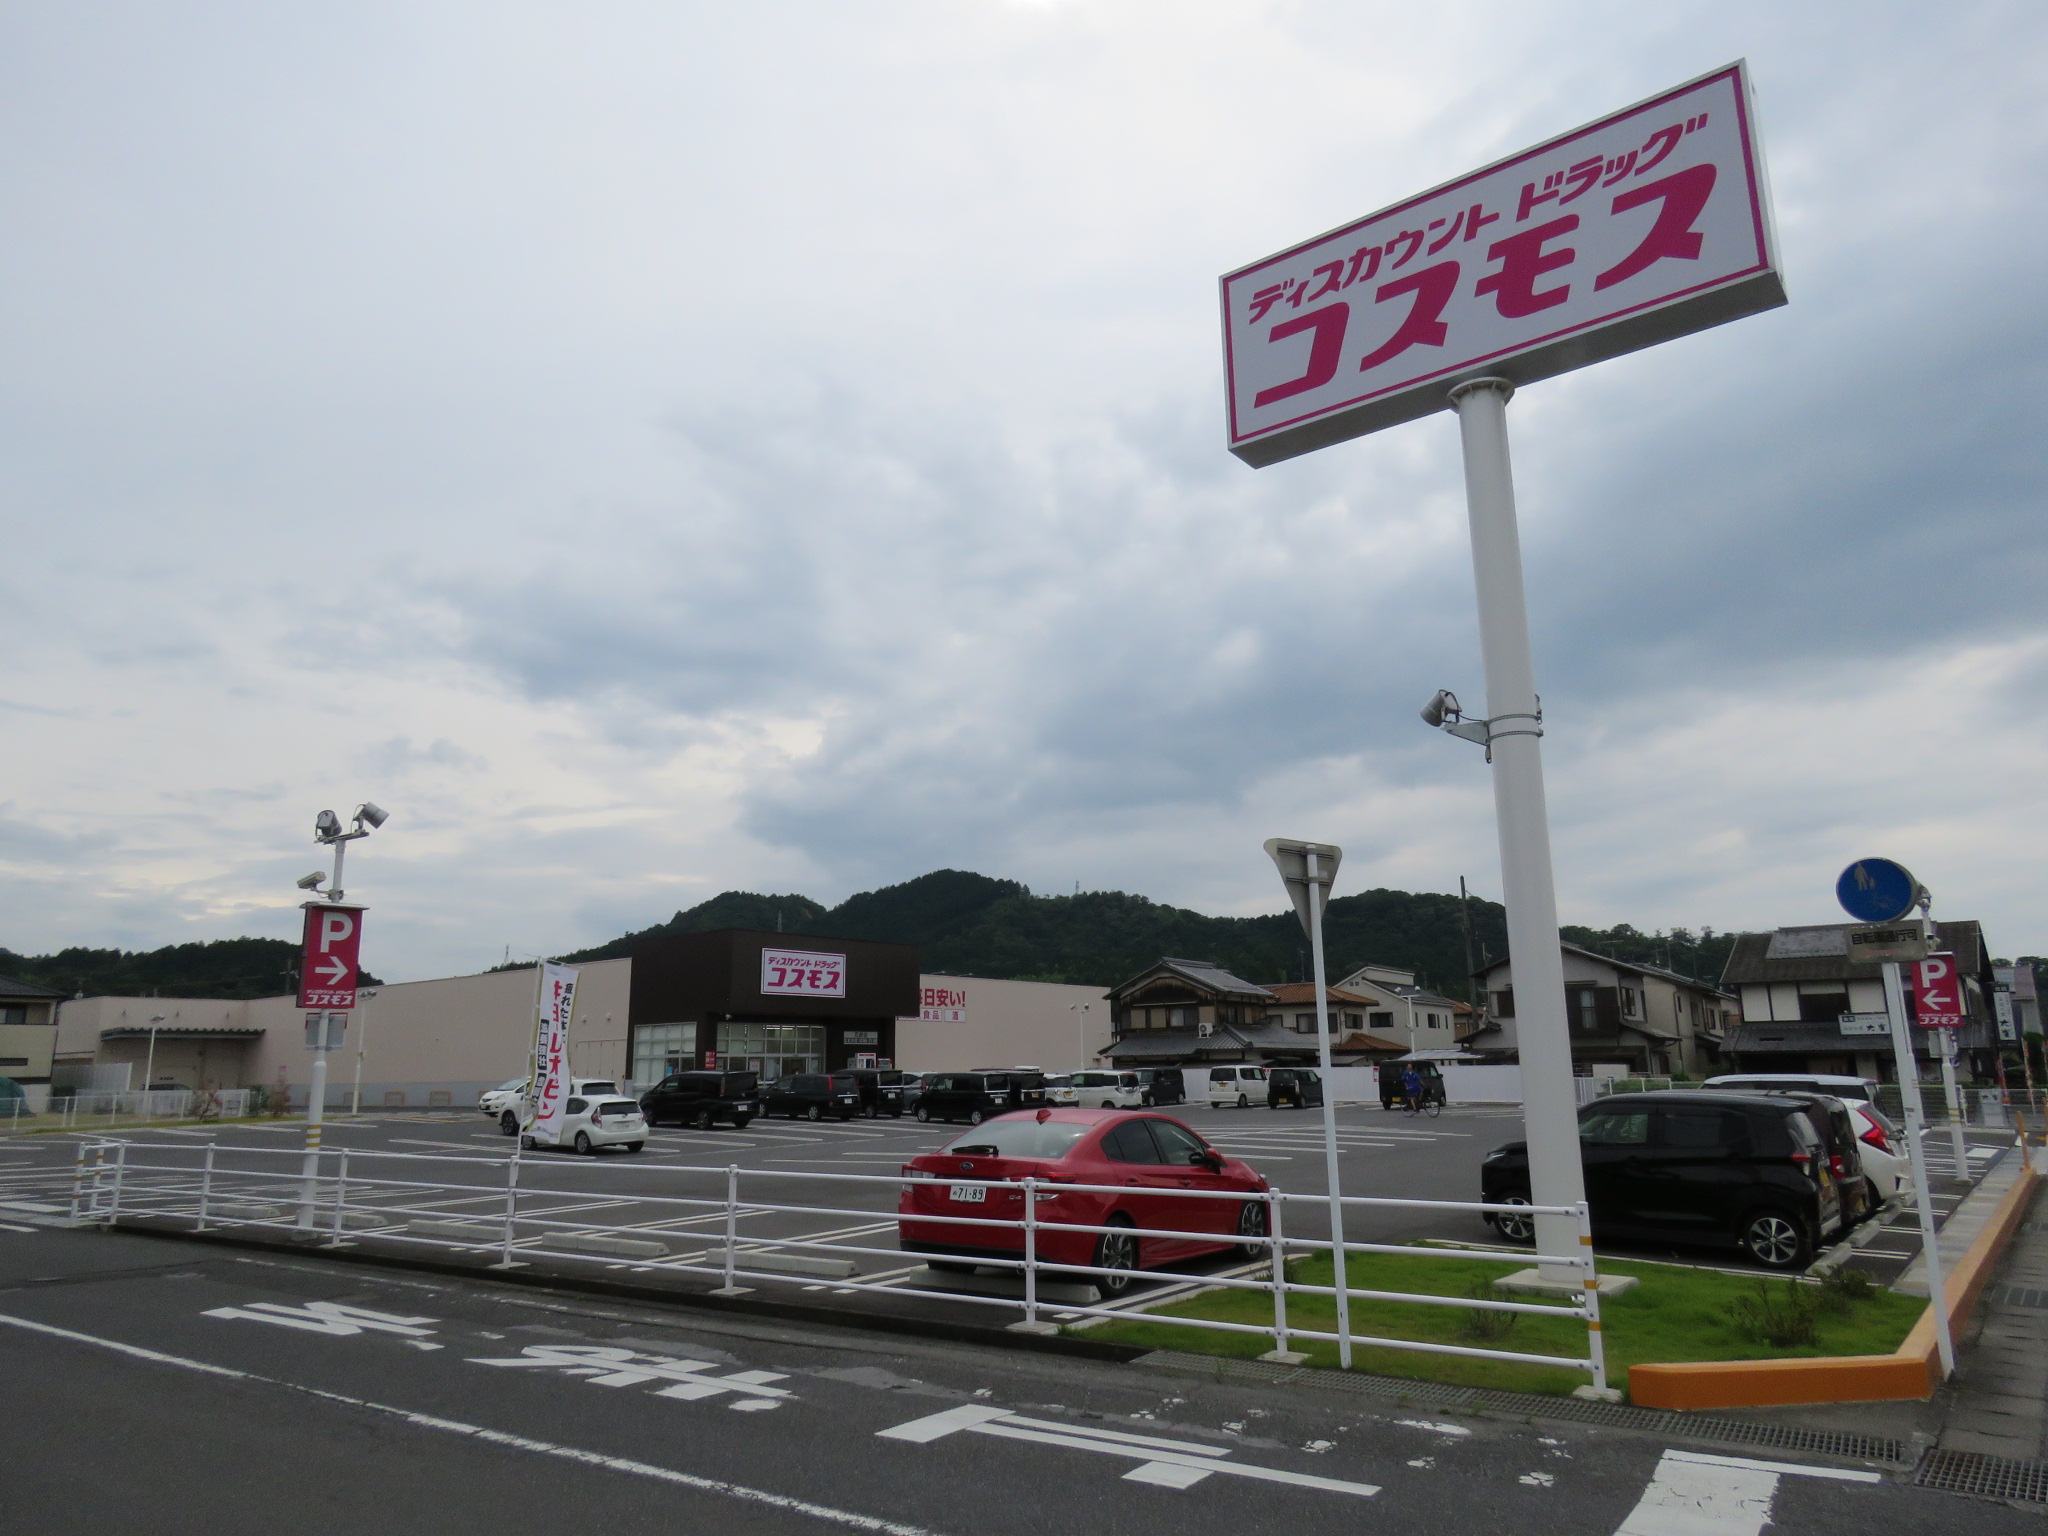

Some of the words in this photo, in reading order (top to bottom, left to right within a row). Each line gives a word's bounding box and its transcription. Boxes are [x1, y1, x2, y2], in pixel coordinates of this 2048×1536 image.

[1248, 203, 1500, 325] ディスカウント
[1516, 113, 1709, 222] ドラッグ
[1253, 162, 1719, 409] コスモス
[320, 911, 353, 953] P
[768, 957, 812, 968] ディスカウント
[813, 960, 841, 970] ドラッグ
[1920, 958, 1948, 988] P
[767, 967, 841, 990] コスモス
[305, 994, 354, 1005] コスモス
[923, 1010, 940, 1021] 食品
[1919, 1016, 1960, 1025] コスモス
